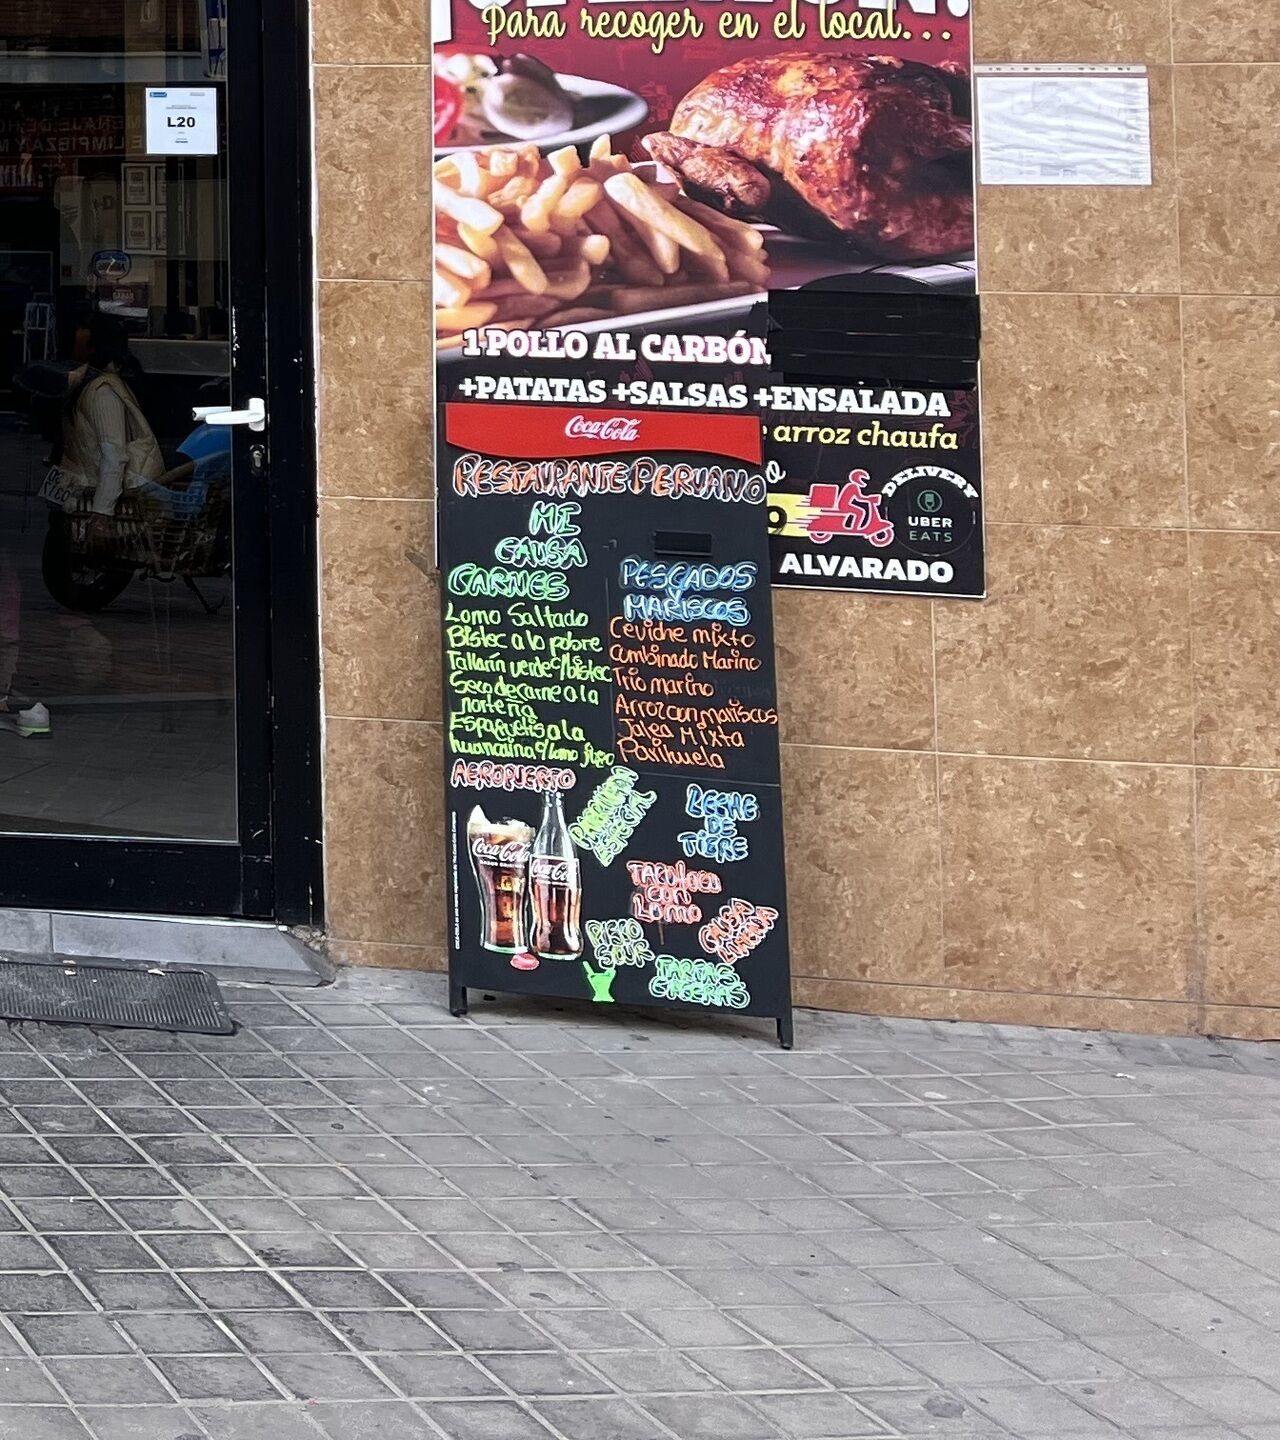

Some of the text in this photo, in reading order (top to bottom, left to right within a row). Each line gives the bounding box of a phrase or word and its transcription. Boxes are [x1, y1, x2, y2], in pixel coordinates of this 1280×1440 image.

[482, 3, 566, 46] Para
[579, 5, 704, 53] recoger
[719, 14, 759, 40] en
[167, 116, 196, 128] L20
[463, 329, 771, 365] 1 POLLO AL CARBÓN
[458, 375, 951, 417] +PATATAS +SALSAS +ENSALADA
[564, 414, 642, 442] Coca-Cola
[773, 425, 851, 445] arroz
[856, 421, 959, 450] chaufa
[453, 453, 629, 498] RESTAURANTE
[629, 456, 766, 504] PERUANO
[881, 465, 979, 498] DELIVERY
[908, 516, 953, 528] UBER
[909, 530, 953, 543] EATS
[495, 536, 588, 570] CAUSA
[779, 553, 954, 583] ALVARADO
[448, 563, 570, 601] CARNES
[620, 555, 757, 591] PESCADOS
[445, 602, 589, 628] Lomo Saltado
[623, 593, 751, 626] MARISCOS
[446, 624, 508, 649] Bistec
[511, 633, 525, 650] a
[549, 631, 603, 657] pobre
[610, 616, 756, 648] Ceviche mixto
[510, 656, 552, 679] verde
[610, 644, 699, 669] Combinado
[650, 672, 714, 696] marino
[616, 736, 725, 769] Parihuela
[450, 758, 577, 792] AEROPUERTO
[686, 783, 760, 821] LECHE
[704, 815, 737, 838] DE
[585, 918, 644, 948] PISCO
[594, 939, 656, 970] SOUR
